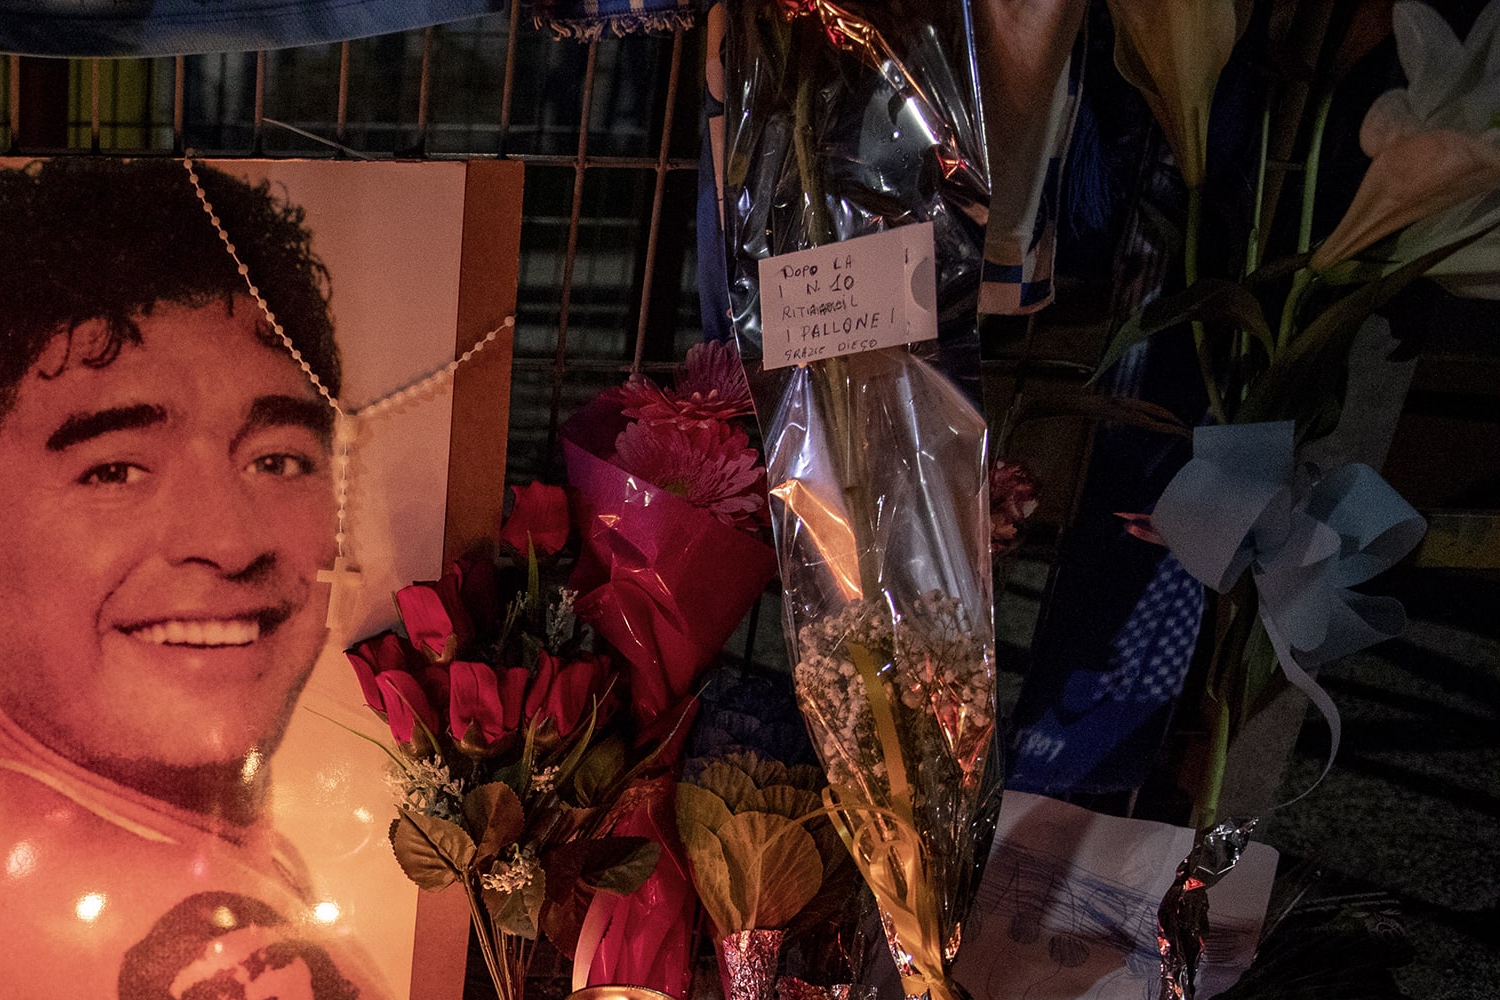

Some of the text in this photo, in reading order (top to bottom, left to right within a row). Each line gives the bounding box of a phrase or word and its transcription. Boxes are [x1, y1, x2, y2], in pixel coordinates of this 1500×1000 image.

[833, 254, 853, 270] LA
[829, 274, 855, 292] 10
[800, 312, 881, 340] PALLONE
[837, 338, 878, 353] DIEGO
